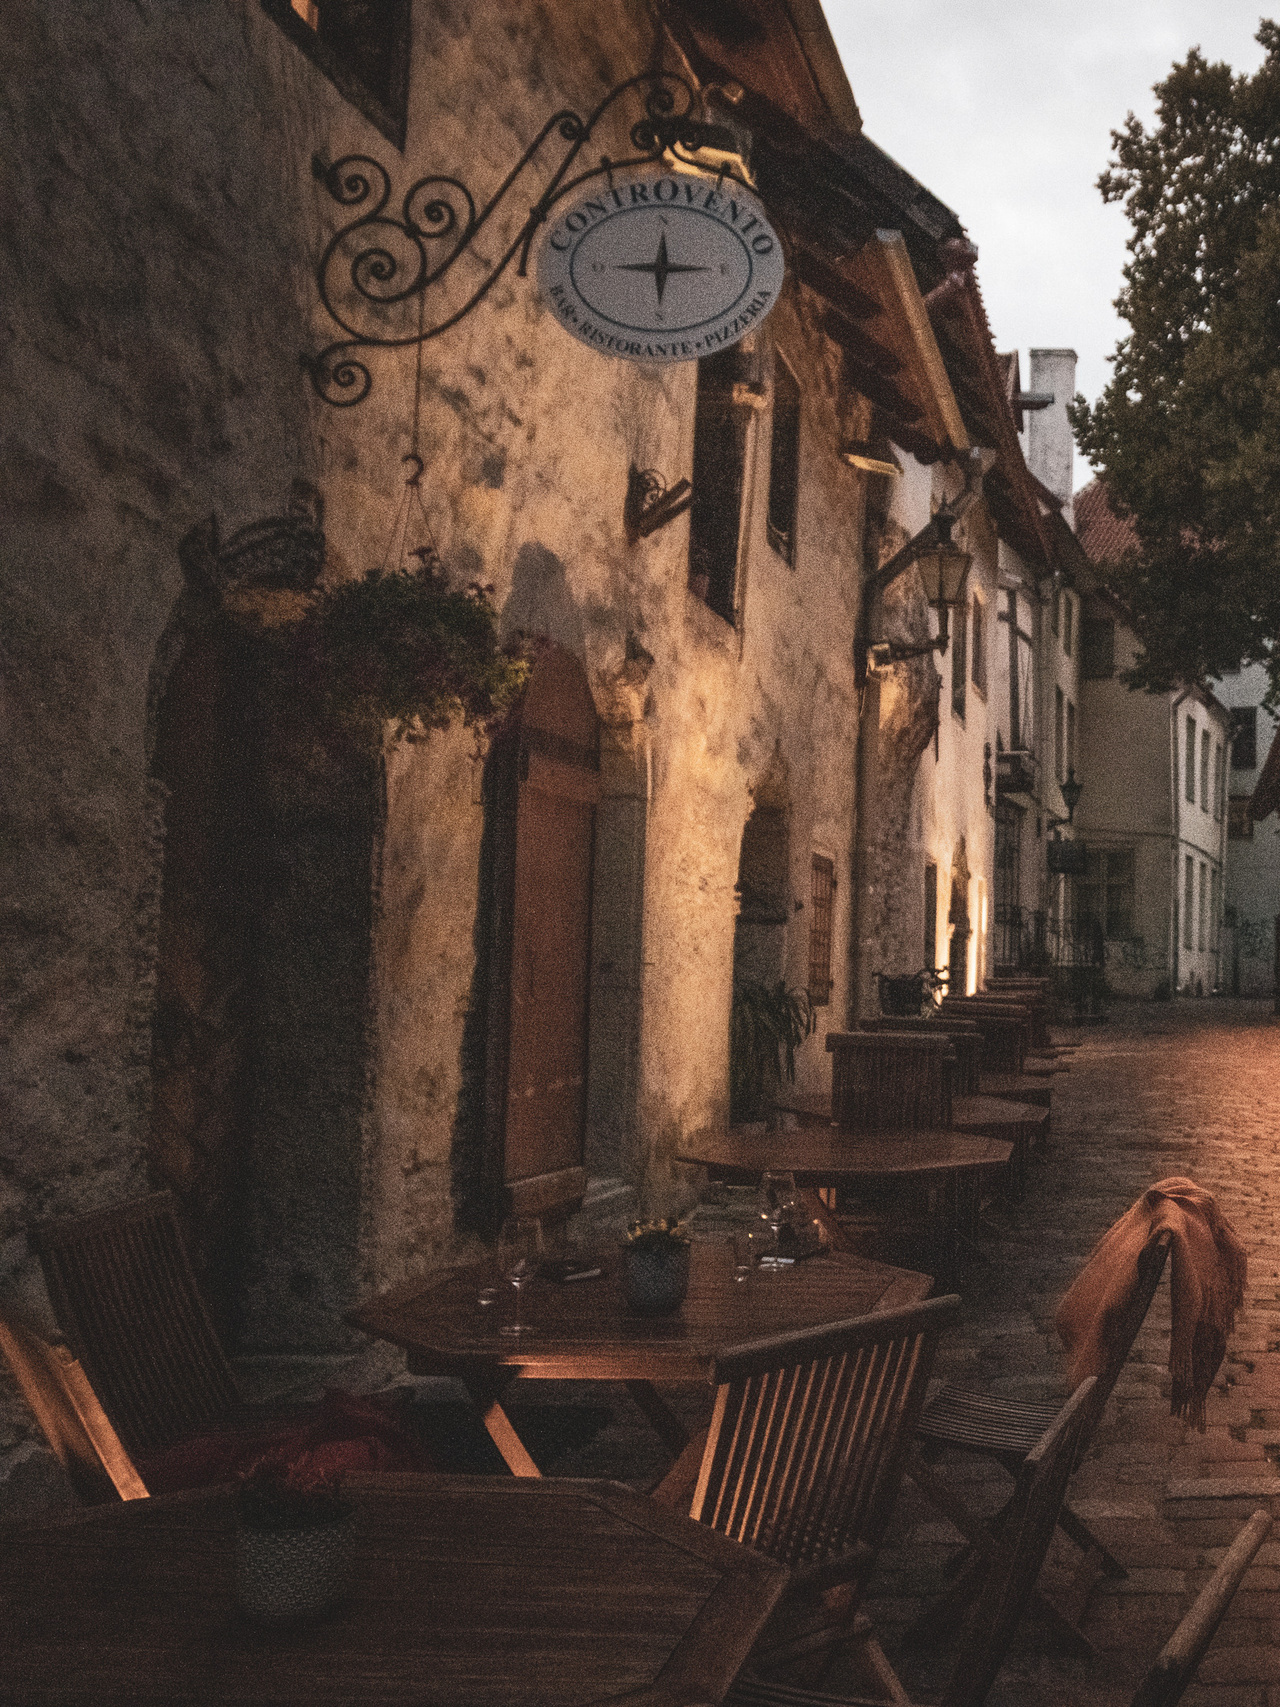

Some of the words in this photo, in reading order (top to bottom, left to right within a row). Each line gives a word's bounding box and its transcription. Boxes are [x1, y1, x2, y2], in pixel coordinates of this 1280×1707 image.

[550, 178, 773, 256] CONTROVENTO
[550, 285, 575, 320] BAR
[578, 321, 693, 356] RISTORANTE
[704, 289, 771, 348] PIZZERIA
